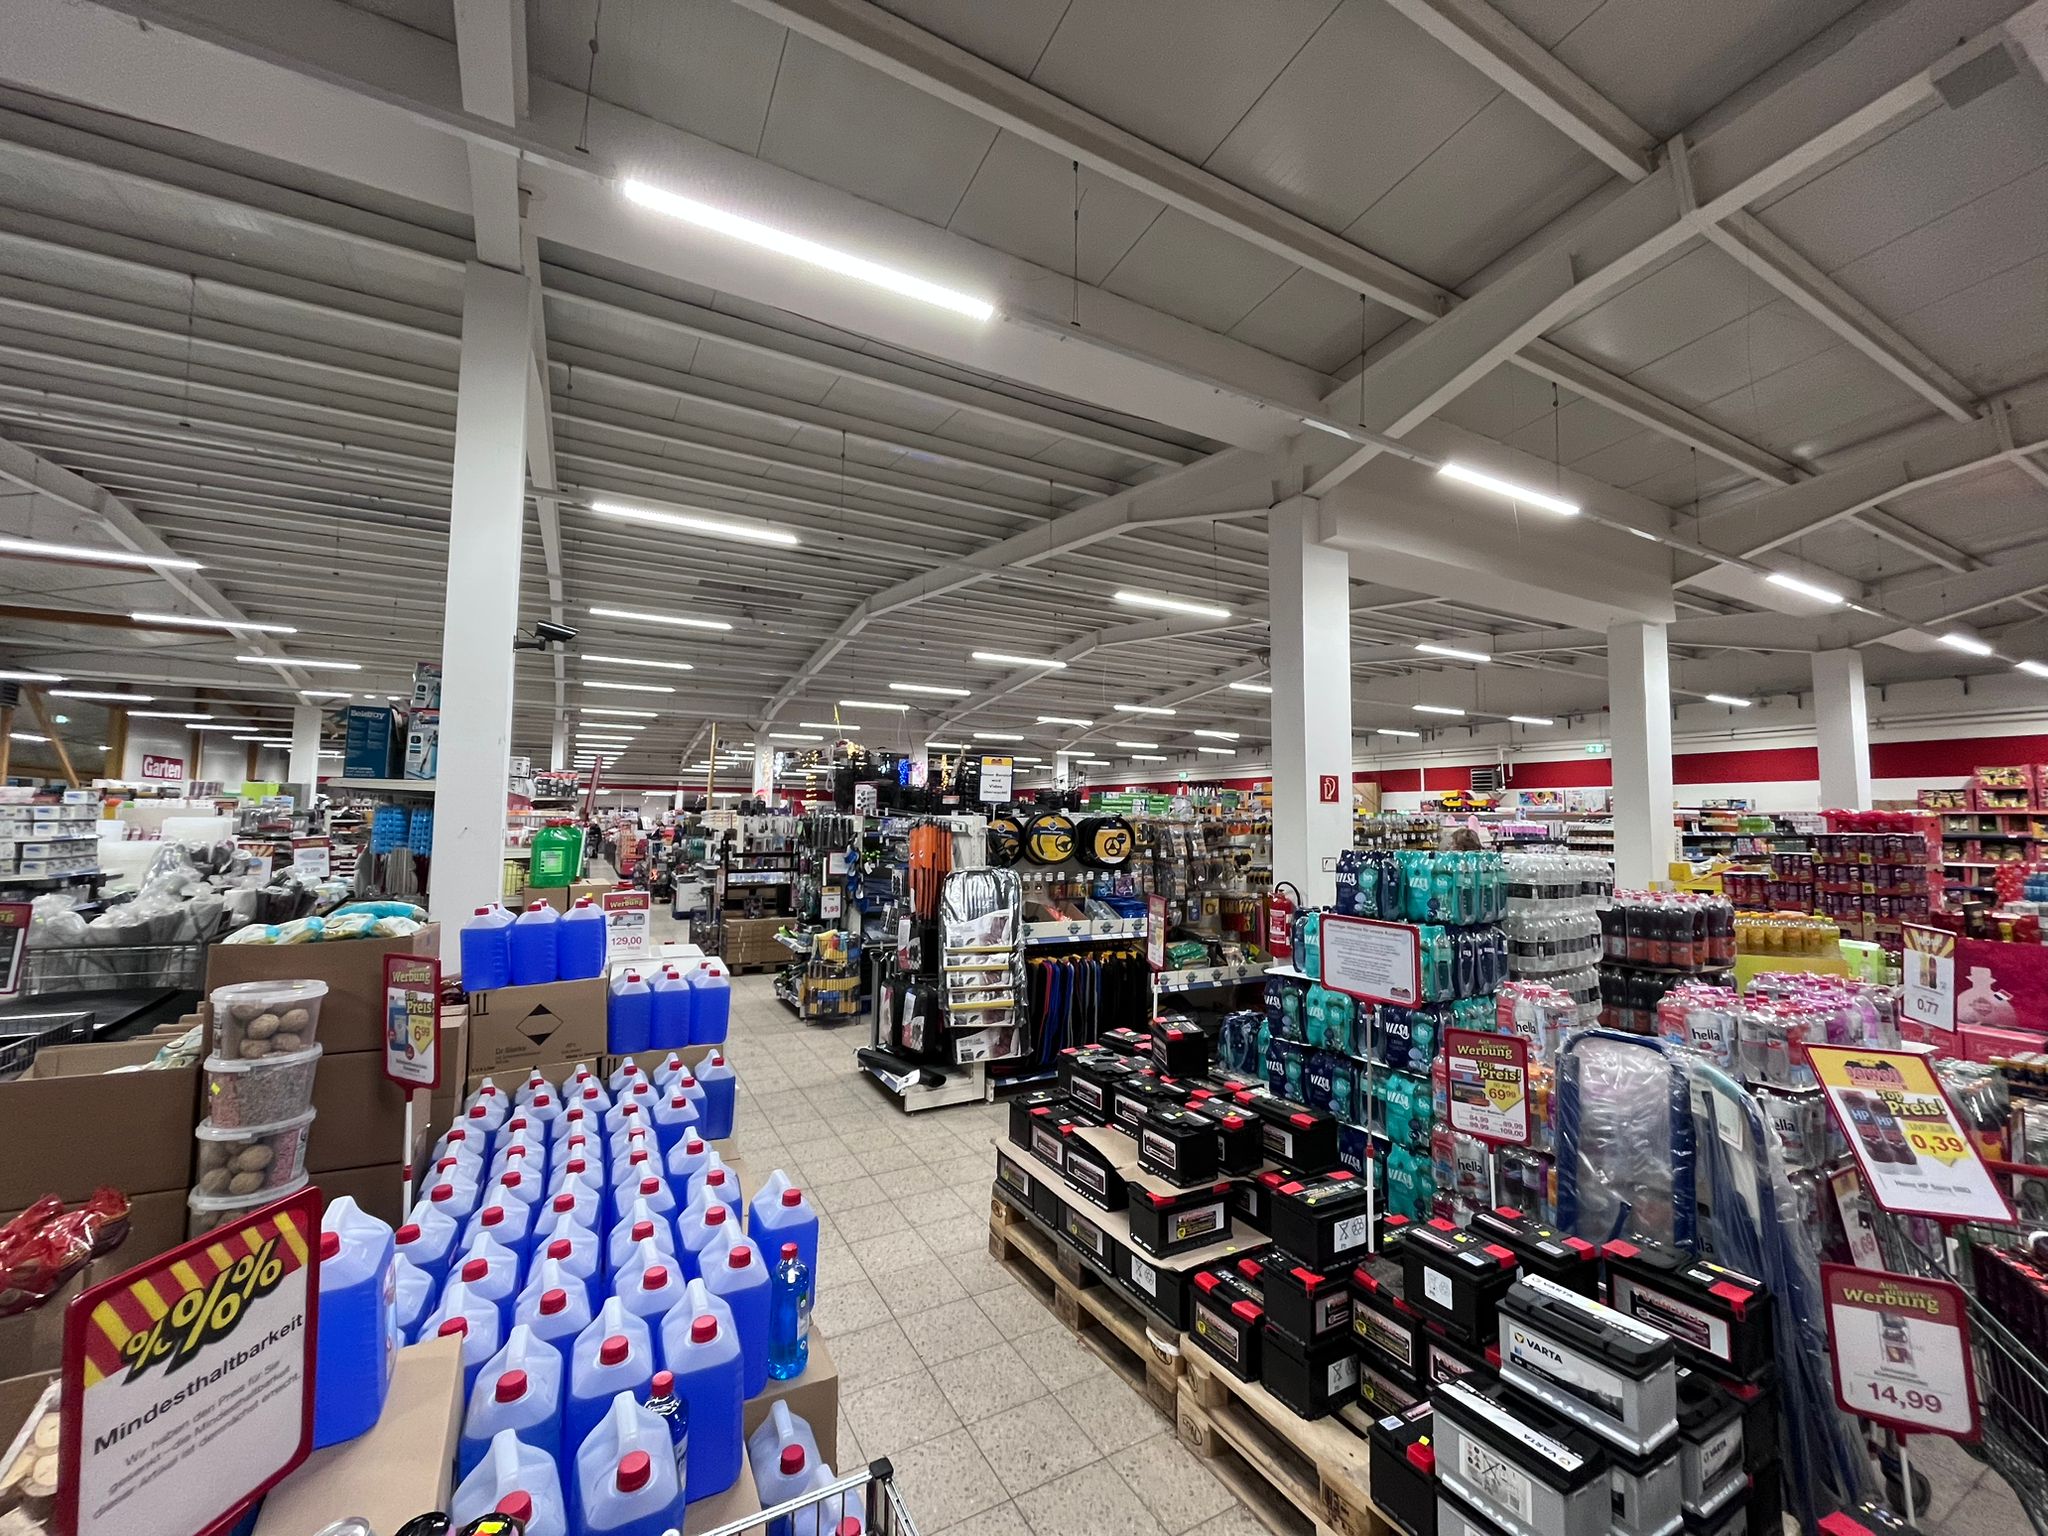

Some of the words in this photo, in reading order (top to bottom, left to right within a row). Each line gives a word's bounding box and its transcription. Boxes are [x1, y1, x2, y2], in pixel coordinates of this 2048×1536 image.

[144, 757, 181, 779] Garten
[609, 898, 644, 909] Werbung
[611, 936, 642, 946] 129,00
[392, 969, 431, 985] Werbung
[406, 998, 435, 1014] Preis!
[1916, 998, 1939, 1015] 0,77
[1385, 1022, 1410, 1040] VILSA
[1516, 1021, 1537, 1034] hella
[1692, 1028, 1721, 1041] hella
[1457, 1045, 1513, 1060] Werbung
[1478, 1060, 1495, 1070] Top
[1310, 1073, 1331, 1092] VILSA
[1480, 1067, 1522, 1081] Preis!
[1387, 1090, 1410, 1110] VILSA
[1879, 1090, 1904, 1103] Top
[1851, 1108, 1870, 1121] HP
[1886, 1097, 1948, 1116] Preis!
[1774, 1118, 1796, 1132] ella
[1876, 1116, 1894, 1127] HP
[1910, 1133, 1964, 1154] 0,39
[1340, 1151, 1362, 1173] VILSA
[1457, 1158, 1483, 1174] hella
[1388, 1168, 1414, 1190] VILSA
[1842, 1287, 1939, 1314] Werbung
[1526, 1337, 1563, 1364] VARTA
[94, 1313, 304, 1456] Mindesthaltbarkeit
[1867, 1382, 1943, 1413] 14,99
[151, 1420, 190, 1450] haben
[1523, 1433, 1557, 1458] VARTA
